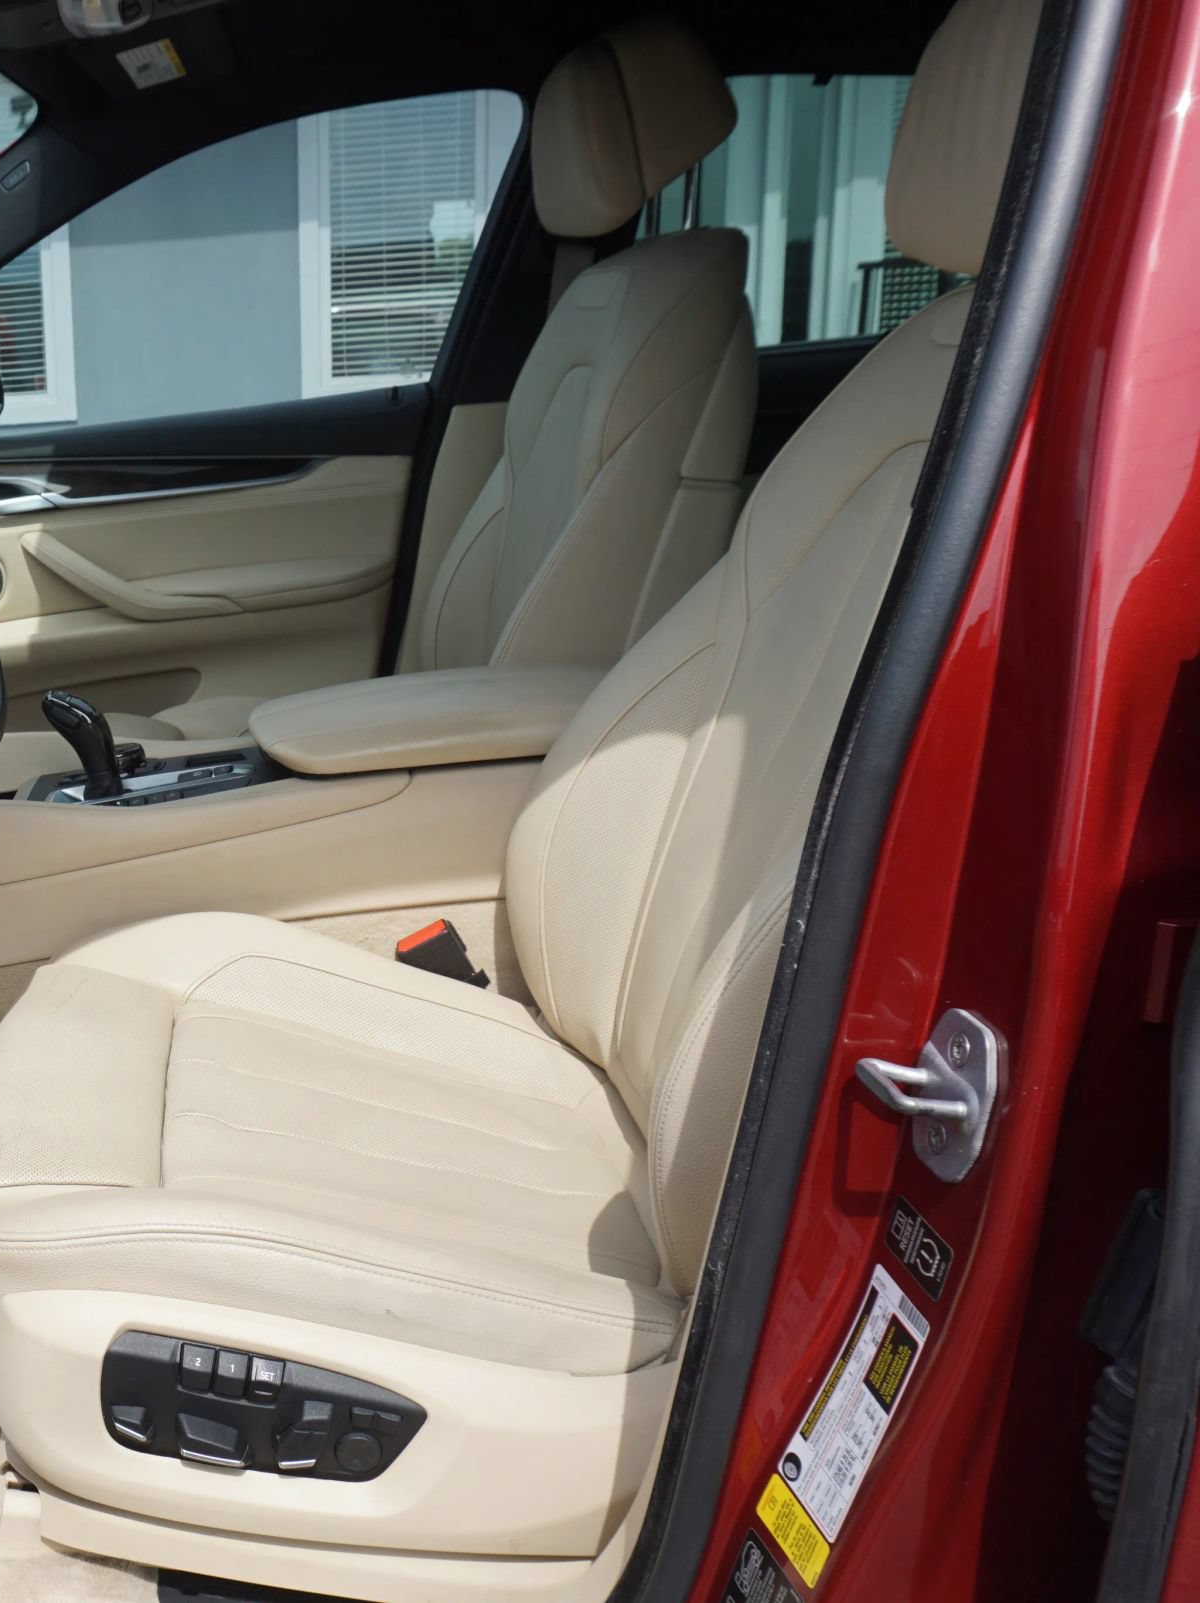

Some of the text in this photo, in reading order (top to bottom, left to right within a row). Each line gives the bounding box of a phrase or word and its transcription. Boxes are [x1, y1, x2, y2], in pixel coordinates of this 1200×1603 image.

[899, 1216, 914, 1251] RESET
[195, 1357, 201, 1366] 2
[260, 1370, 275, 1381] SET
